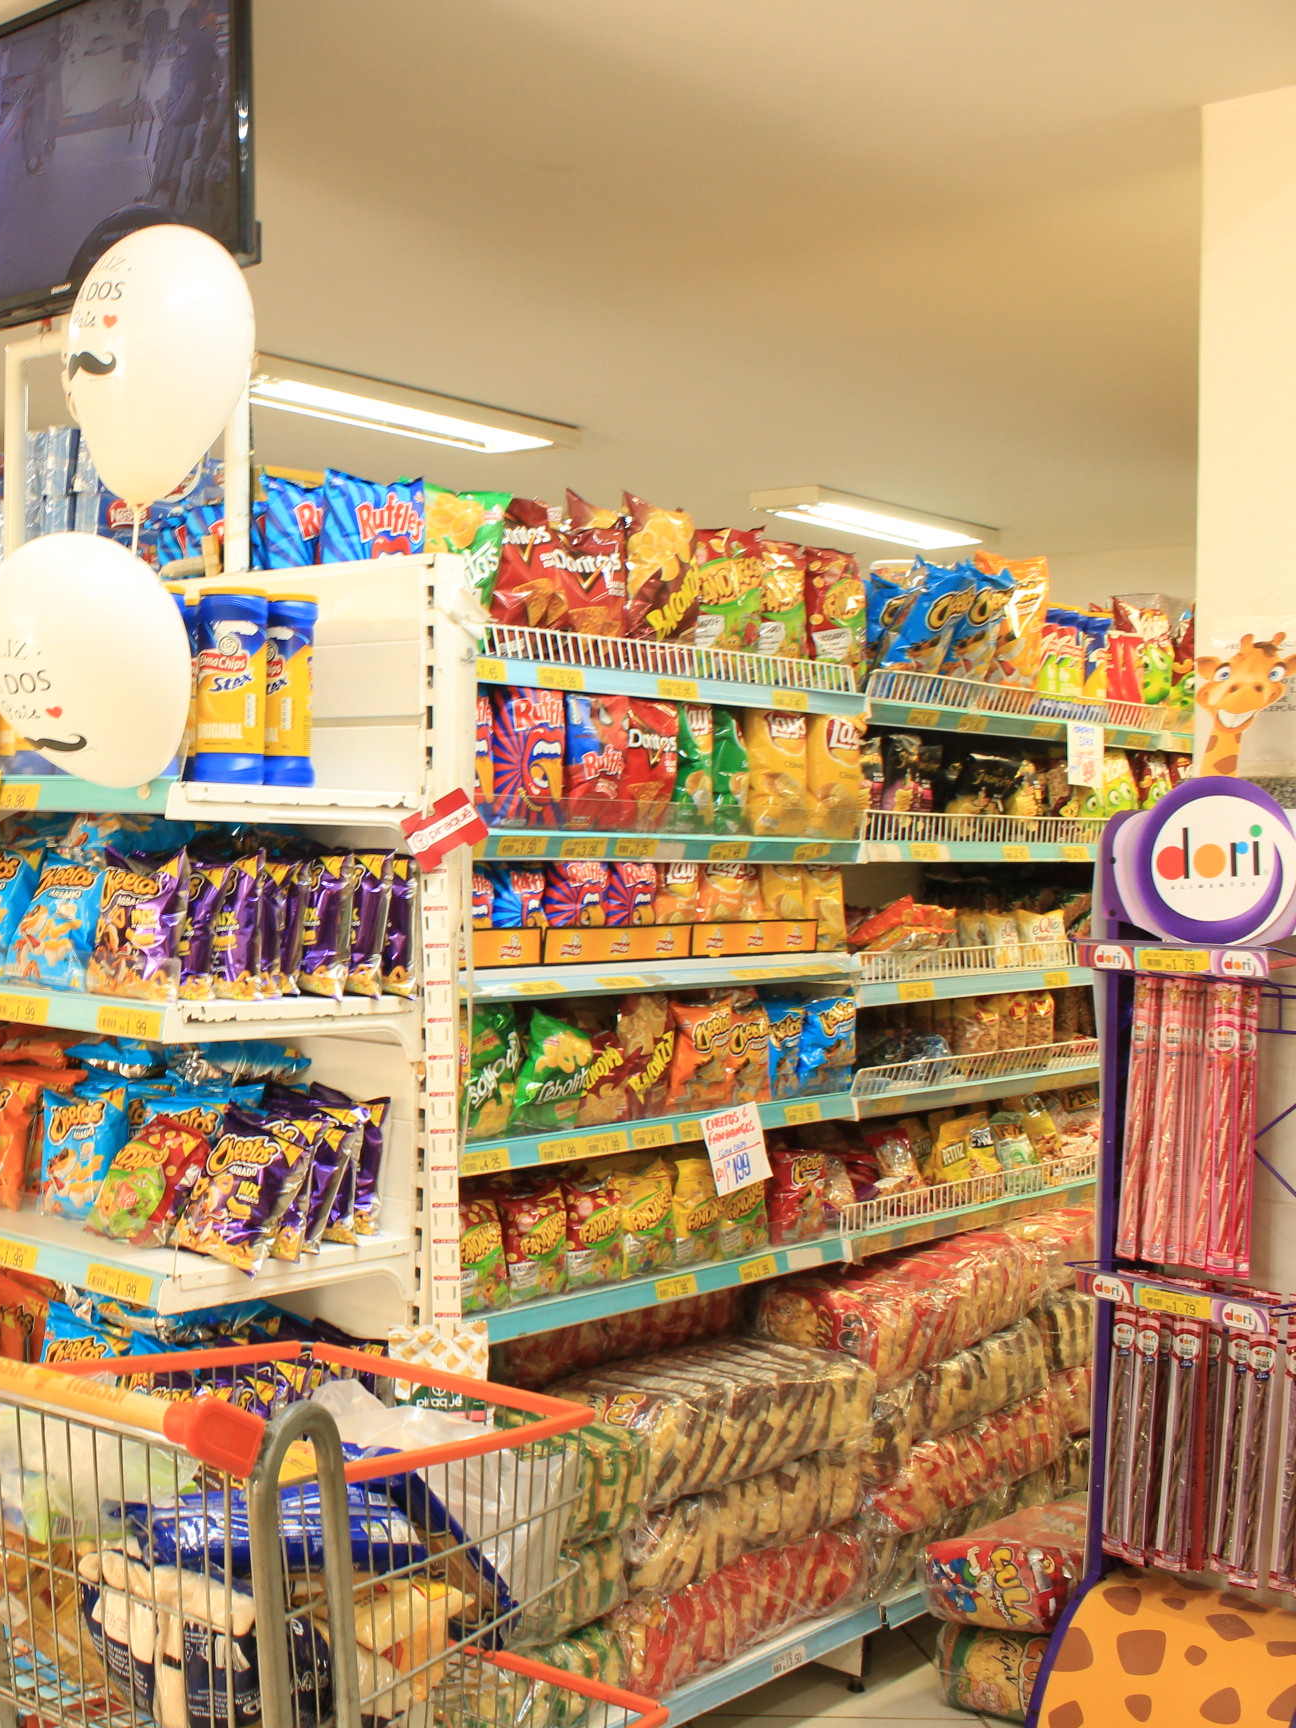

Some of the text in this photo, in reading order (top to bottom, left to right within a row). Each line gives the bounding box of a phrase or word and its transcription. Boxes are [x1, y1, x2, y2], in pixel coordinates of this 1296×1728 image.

[84, 279, 126, 302] DOS
[354, 491, 424, 544] Ruffles
[554, 548, 622, 573] Doritos
[3, 668, 51, 696] DOS
[208, 669, 254, 693] Stax
[627, 728, 678, 752] Doritos
[1157, 824, 1262, 880] dori
[48, 888, 82, 900] ASSADO
[1170, 881, 1256, 891] ALIMENTOS
[1096, 951, 1121, 965] dori
[1172, 958, 1196, 971] 1.79
[1223, 957, 1253, 971] dori
[15, 1006, 36, 1023] 1.99
[125, 1018, 147, 1037] 1.99
[705, 1111, 740, 1132] CHEETOS
[206, 1133, 281, 1177] Cheetos
[941, 1143, 966, 1166] PETTIZ
[239, 1180, 260, 1198] MIX
[3, 1250, 25, 1268] 1.99
[114, 1281, 137, 1298] 1.99
[1095, 1280, 1122, 1297] dori
[1172, 1301, 1196, 1316] 1.79
[1224, 1308, 1254, 1326] dori
